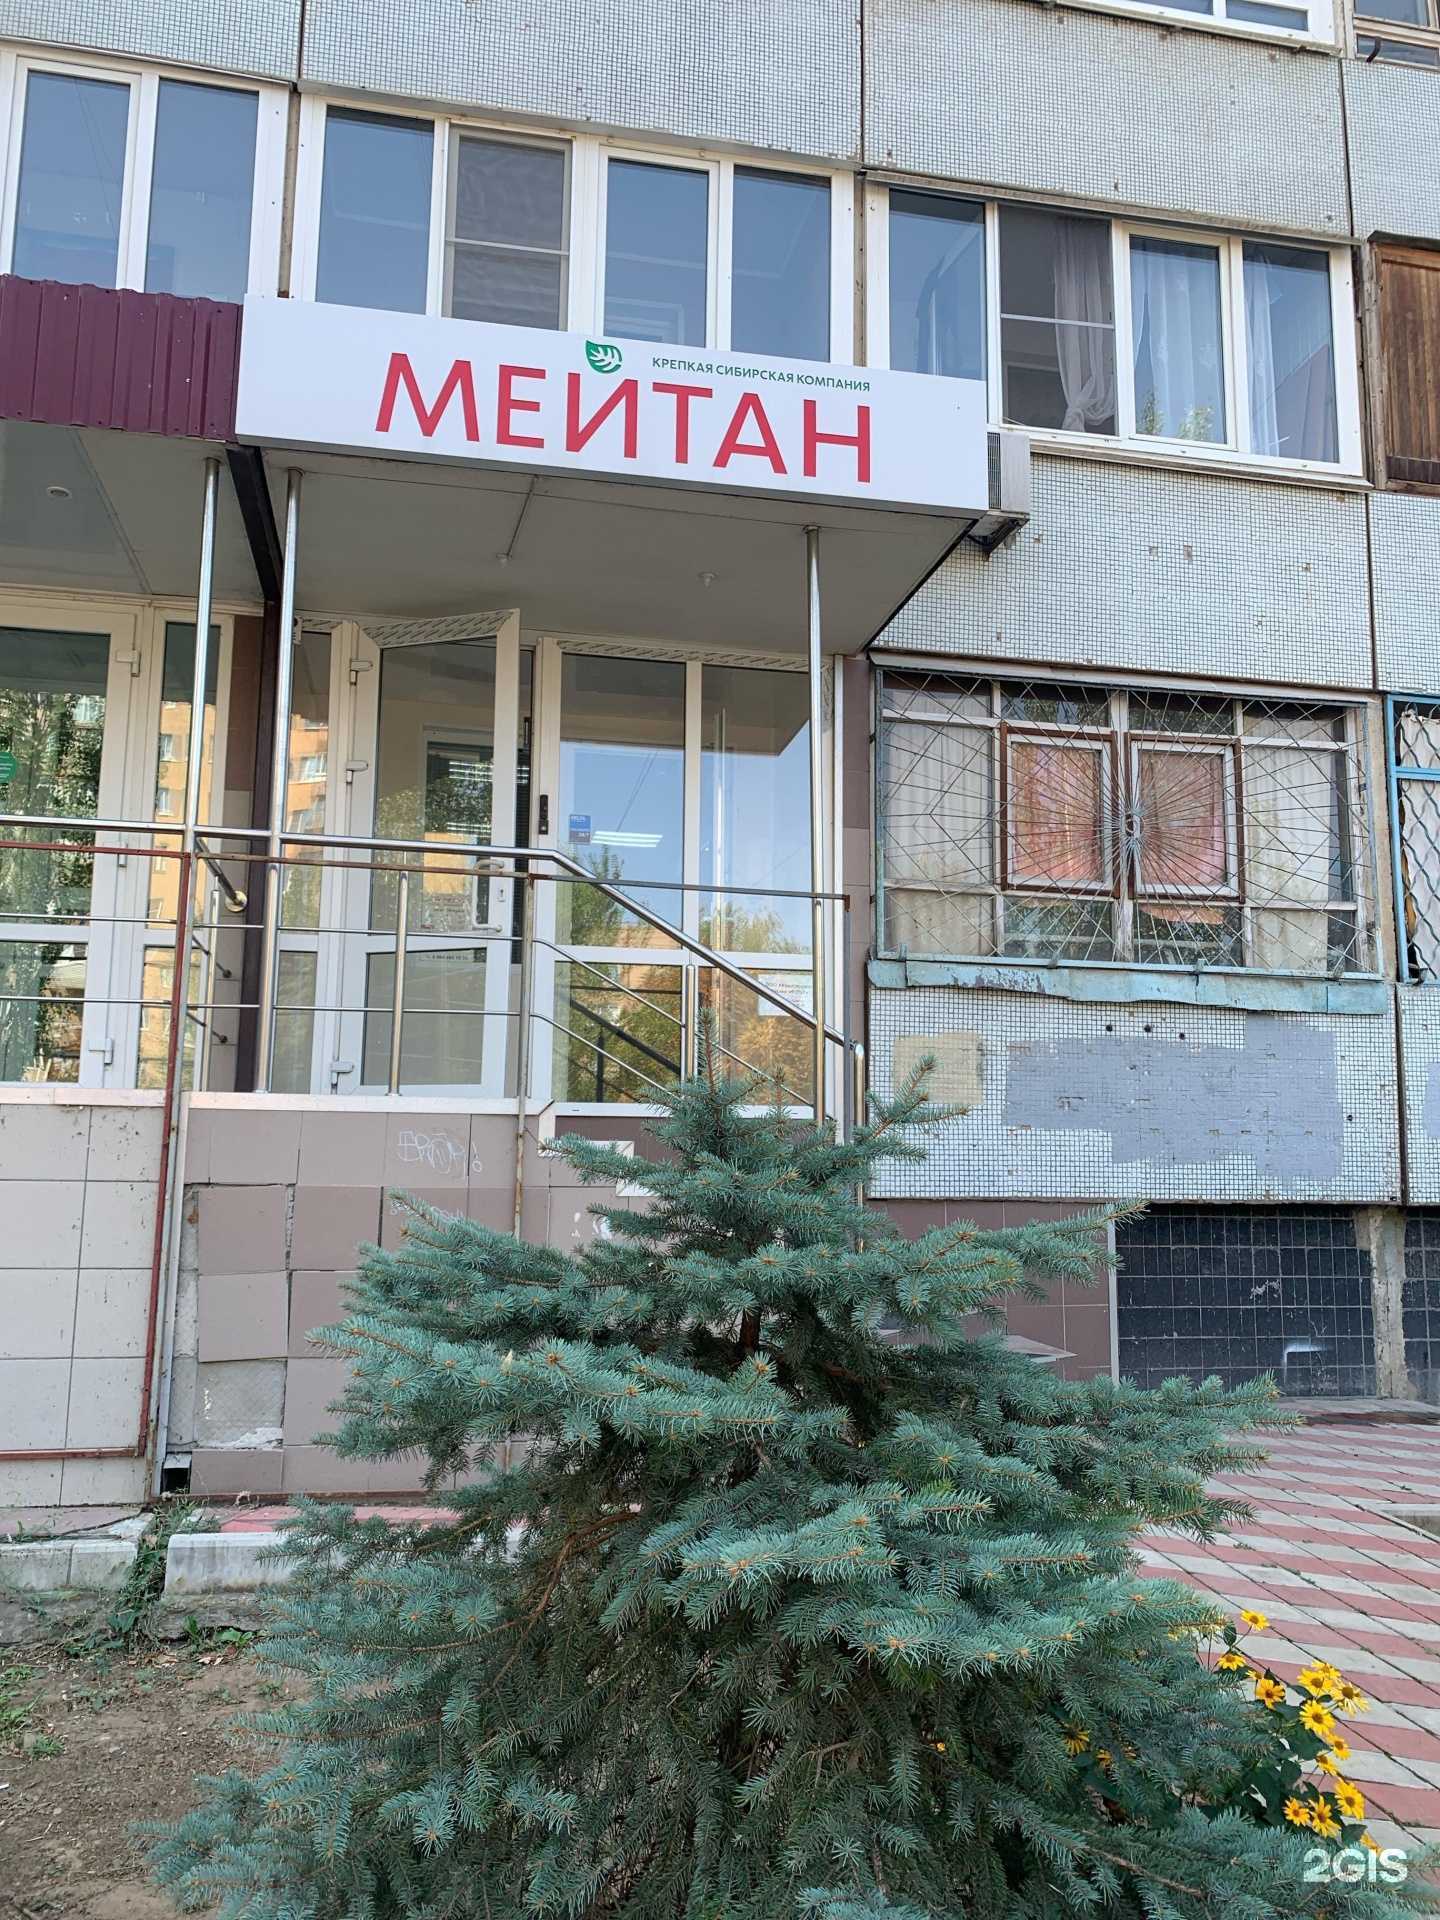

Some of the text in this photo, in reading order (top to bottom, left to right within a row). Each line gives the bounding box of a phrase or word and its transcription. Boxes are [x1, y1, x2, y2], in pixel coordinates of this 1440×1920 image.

[652, 357, 870, 392] КРЕПКАЯ СИБИРСКАЯ КОМПАНИЯ
